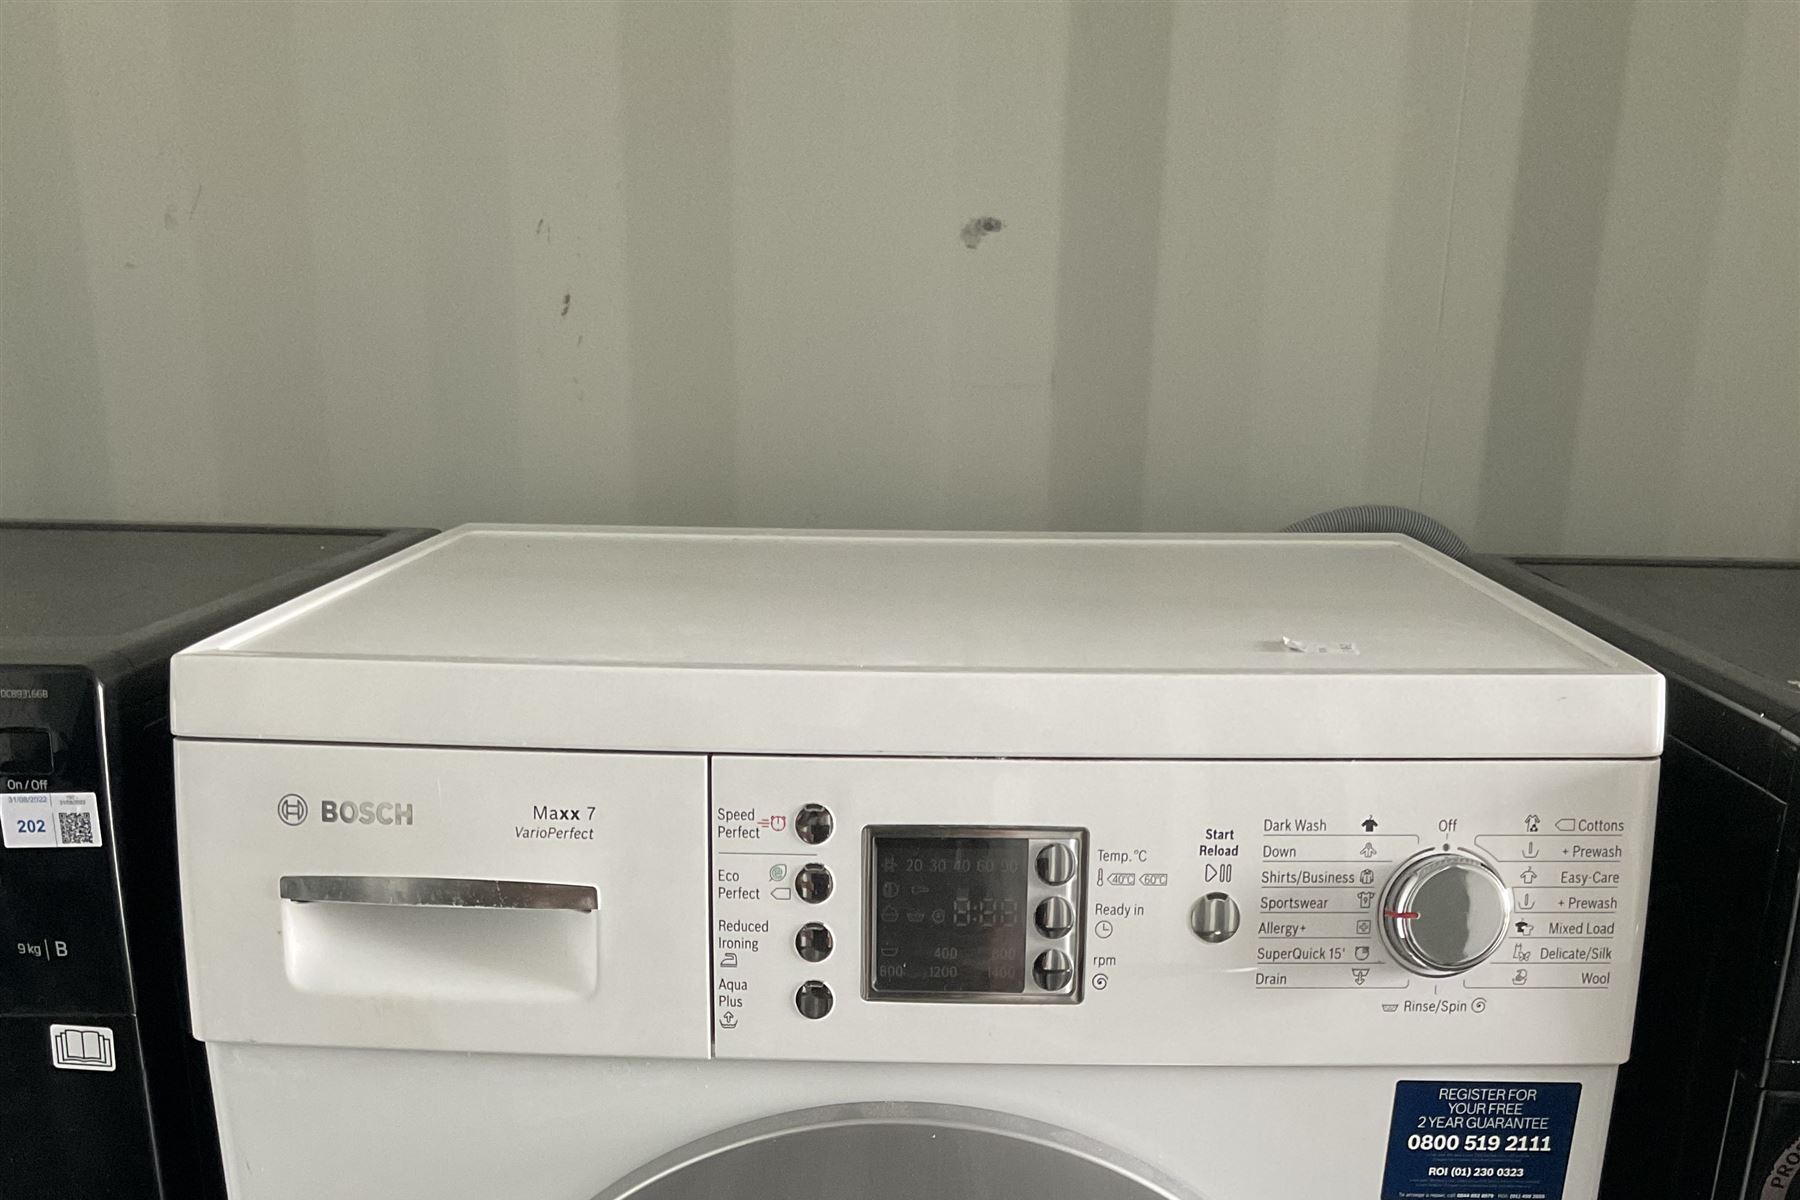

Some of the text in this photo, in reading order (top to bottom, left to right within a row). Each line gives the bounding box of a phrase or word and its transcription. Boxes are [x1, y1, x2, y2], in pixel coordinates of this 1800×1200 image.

[8, 780, 22, 790] On
[31, 780, 48, 790] Off
[321, 800, 413, 825] BOSCH
[533, 805, 595, 820] Maxx 7
[718, 808, 755, 822] Speed
[17, 820, 46, 833] 202
[718, 825, 760, 839] Perfect
[1264, 820, 1327, 831] Dark Wash
[1439, 820, 1457, 832] Off
[1578, 820, 1624, 832] Cottons
[515, 826, 594, 840] VarioPerfect
[1205, 829, 1234, 840] Start
[1098, 849, 1147, 864] Temp. °C
[1199, 845, 1239, 856] Reload
[1263, 846, 1296, 858] Down
[1572, 846, 1622, 858] Prewash
[718, 870, 739, 882] Eco
[1261, 871, 1355, 885] Shirts/Business
[1560, 871, 1620, 885] Easy-Care
[718, 887, 760, 900] Perfect
[1260, 897, 1328, 912] Sportswear
[1568, 897, 1618, 909] Prewash
[1095, 904, 1144, 918] Ready in
[718, 920, 769, 932] Reduced
[1258, 922, 1306, 937] Allergy+
[1549, 923, 1614, 934] Mixed Load
[55, 941, 68, 956] B
[718, 937, 759, 952] Ironing
[1257, 947, 1346, 961] SuperQuick 15'
[1540, 947, 1612, 960] Delicate/Silk
[1094, 956, 1116, 967] rpm
[1256, 973, 1287, 985] Drain
[1581, 972, 1611, 985] Wool
[719, 979, 748, 993] Aqua
[719, 996, 743, 1007] Plus
[1403, 1000, 1467, 1014] Rinse/Spin
[1439, 1088, 1537, 1100] REGISTER FOR
[1449, 1103, 1523, 1115] YOUR FREE
[1417, 1117, 1549, 1129] 2 YEAR GUARANTEE
[1408, 1134, 1551, 1151] 0800 519 2111
[1429, 1167, 1524, 1177] ROI (01) 230 0323
